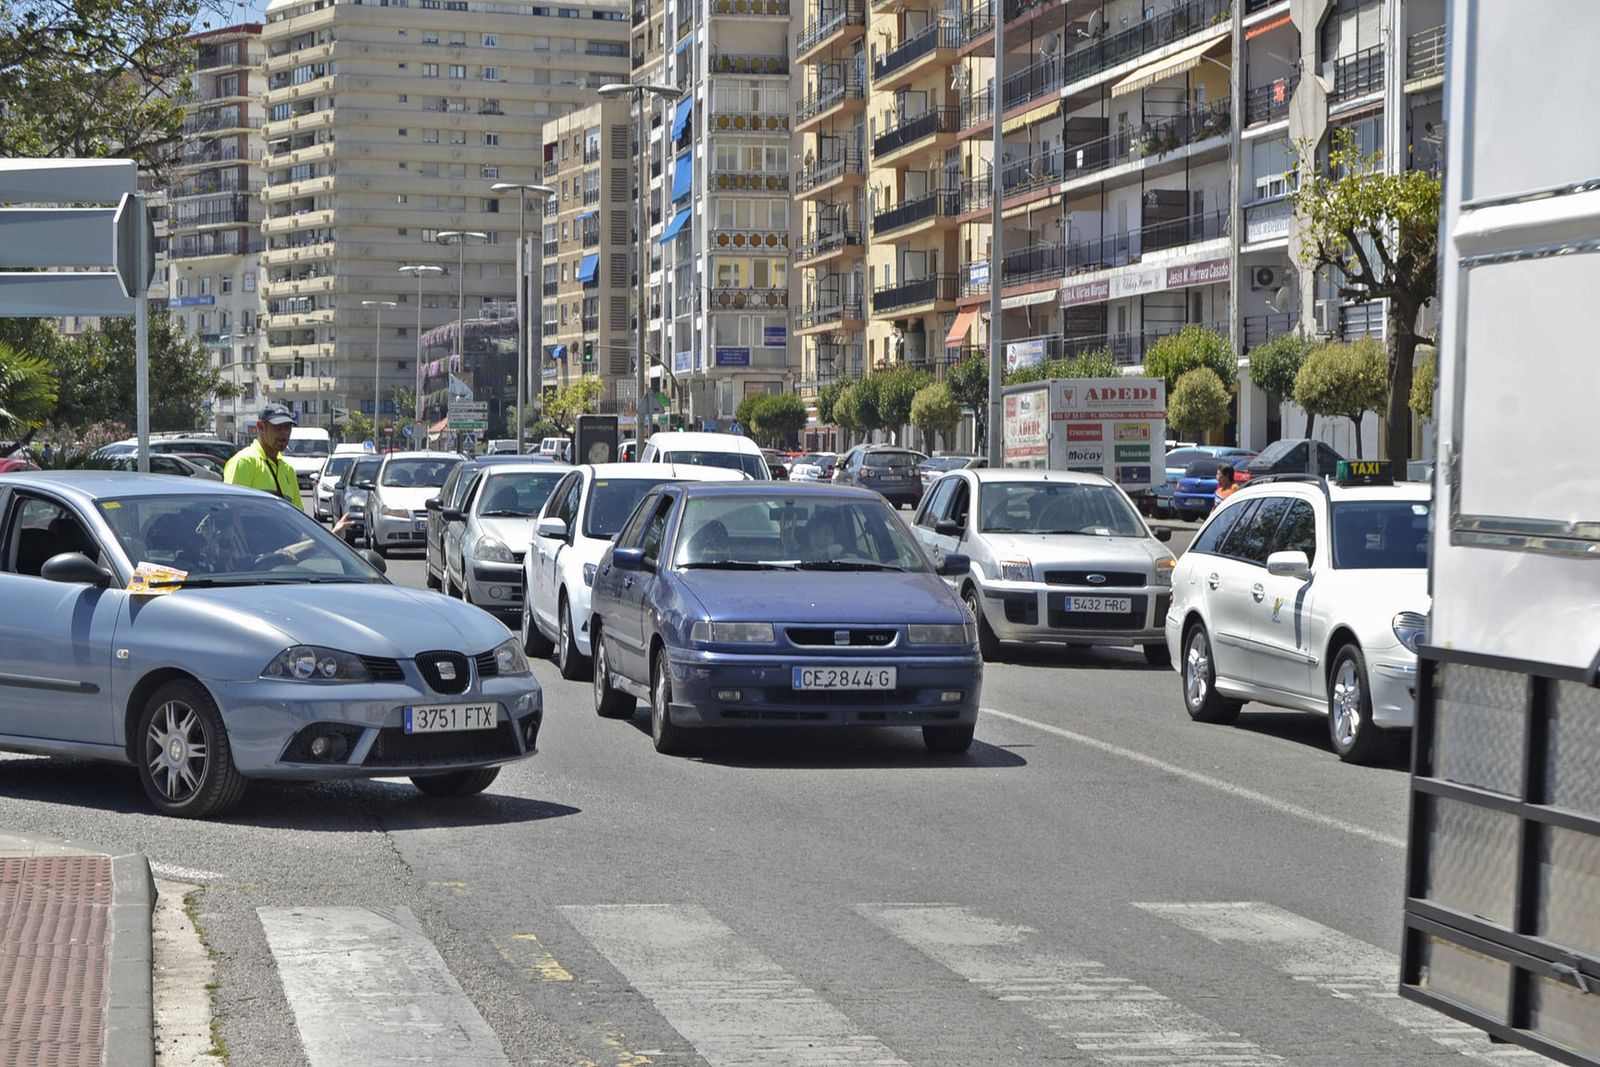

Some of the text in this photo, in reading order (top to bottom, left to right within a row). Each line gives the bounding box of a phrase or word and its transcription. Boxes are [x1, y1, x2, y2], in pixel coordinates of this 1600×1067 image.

[1190, 267, 1209, 281] Herrera
[1209, 262, 1229, 278] Casado
[1085, 387, 1157, 401] ADEDI
[1069, 429, 1101, 437] Cruzcampo
[1068, 450, 1102, 461] Mocay
[1350, 463, 1380, 475] TAXI
[1074, 598, 1127, 611] 5432 FRC
[417, 706, 492, 729] 3751 FTX
